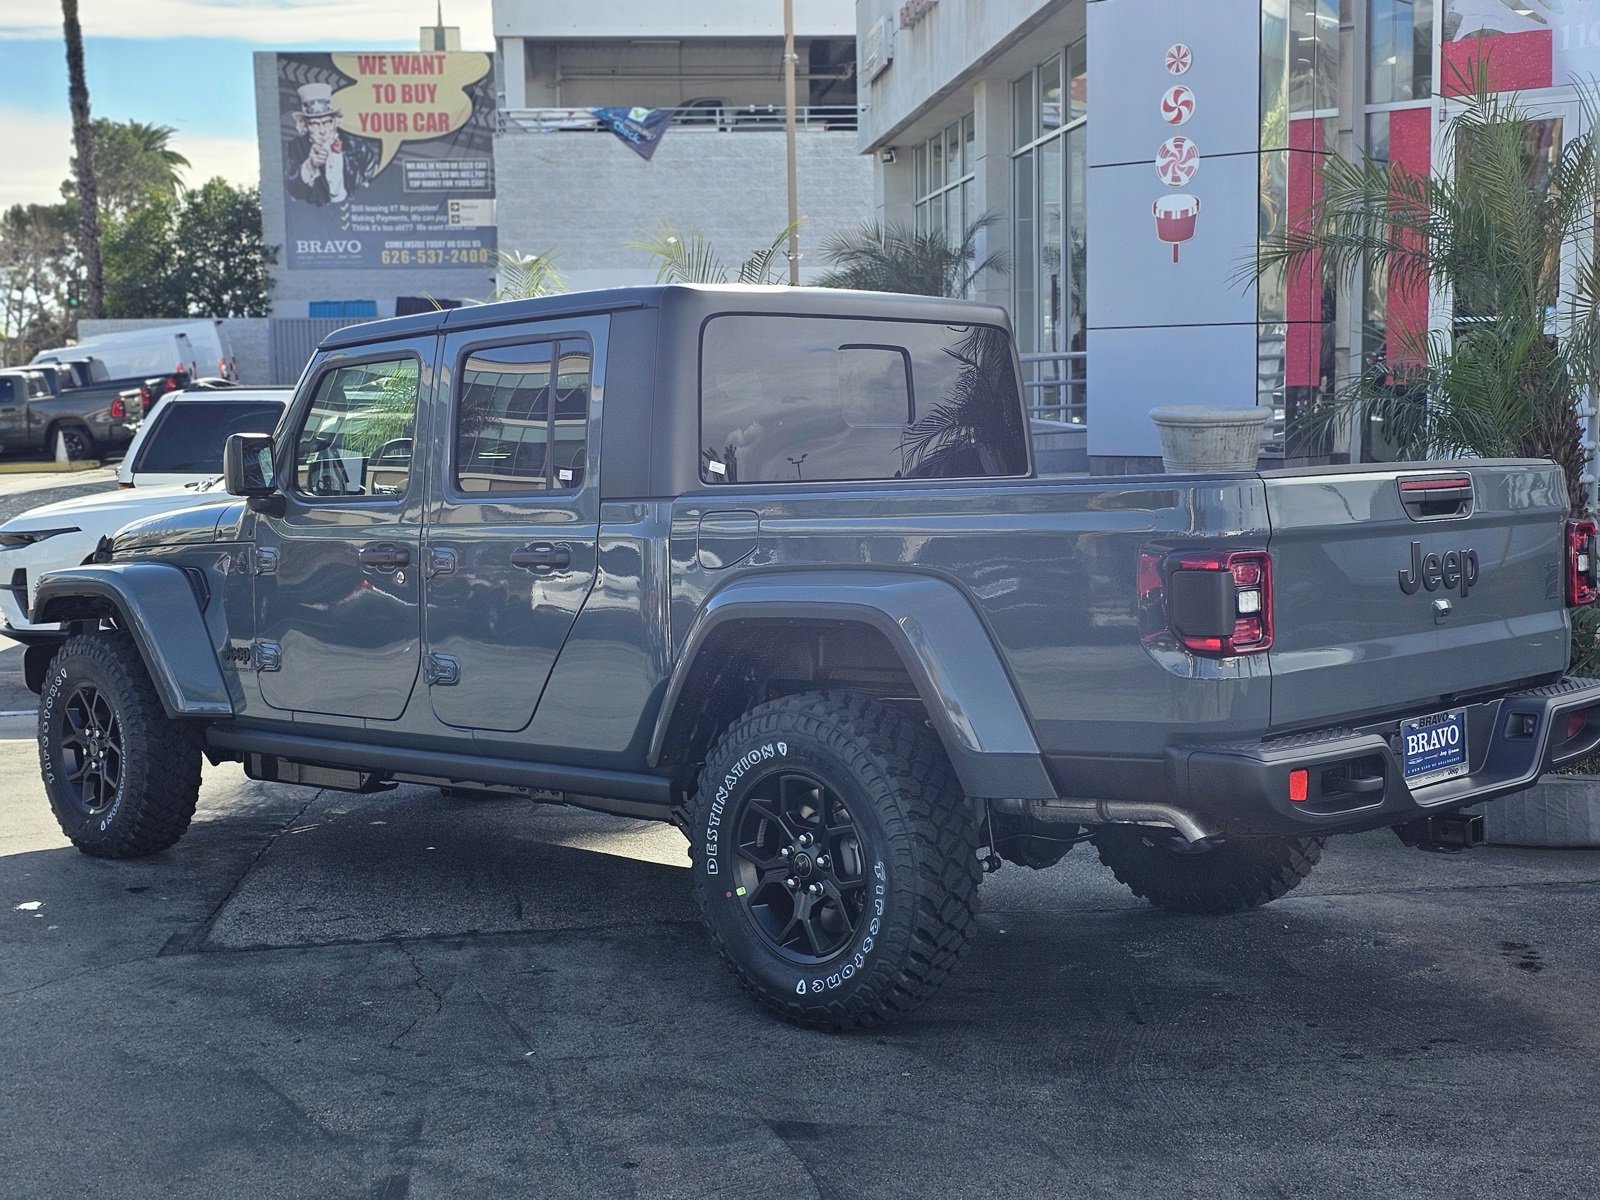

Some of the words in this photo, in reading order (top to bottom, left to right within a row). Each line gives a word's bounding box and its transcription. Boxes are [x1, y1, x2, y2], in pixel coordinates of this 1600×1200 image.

[357, 55, 387, 75] WE
[391, 55, 446, 75] WANT
[372, 83, 396, 104] TO
[401, 83, 438, 104] BUY
[358, 112, 408, 133] YOUR
[412, 112, 450, 133] CAR
[351, 204, 364, 212] Still
[365, 205, 389, 214] leasing
[351, 214, 376, 223] Making
[411, 214, 422, 222] We
[352, 224, 371, 232] Think
[382, 224, 394, 232] too
[416, 224, 427, 232] We
[296, 239, 362, 254] BRAVO
[381, 249, 488, 265] 626-537-2400
[1398, 540, 1480, 598] Jeep
[223, 646, 251, 665] Jeep
[1418, 711, 1449, 728] BRAVO
[1406, 724, 1460, 756] BRAVO
[706, 743, 775, 876] DESTINATION
[811, 859, 887, 994] Firestone
